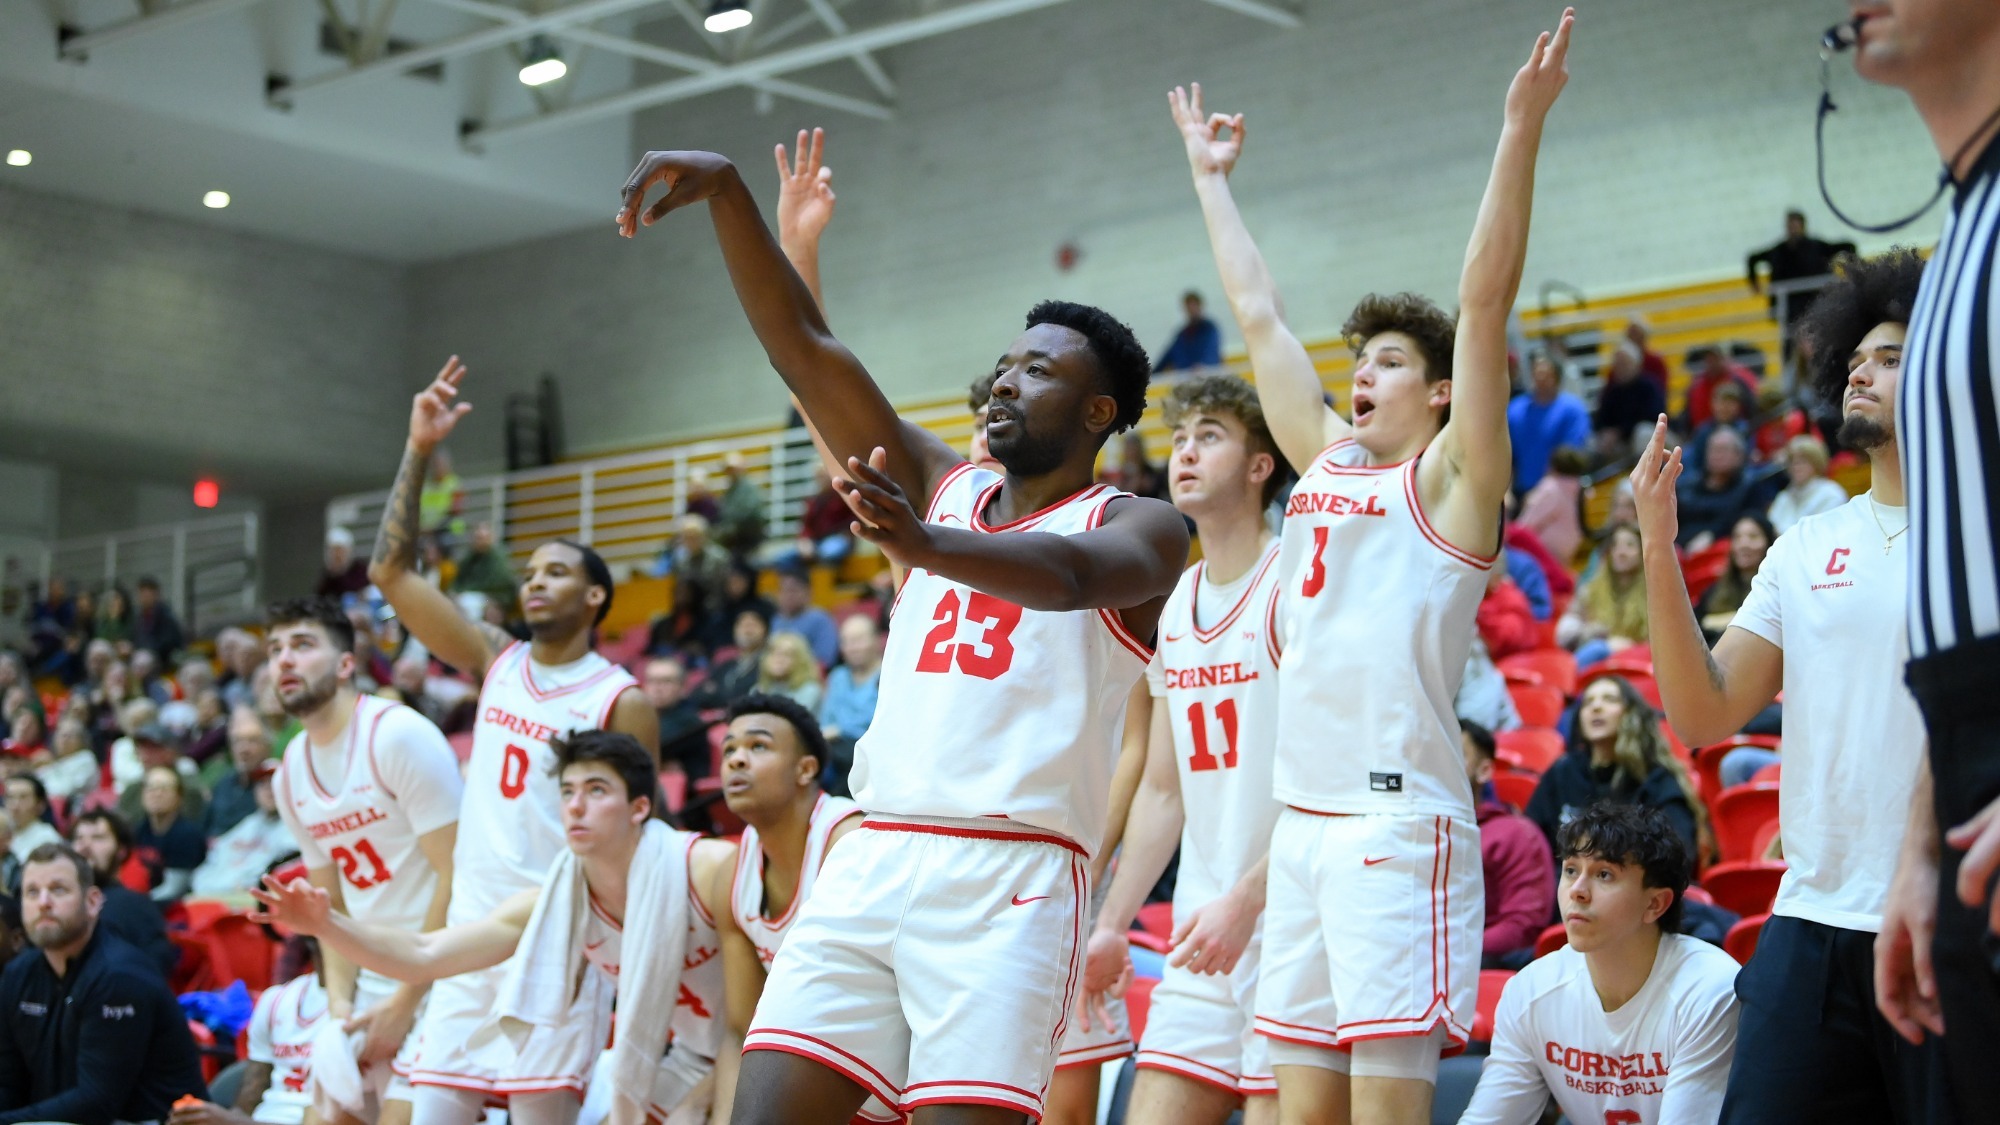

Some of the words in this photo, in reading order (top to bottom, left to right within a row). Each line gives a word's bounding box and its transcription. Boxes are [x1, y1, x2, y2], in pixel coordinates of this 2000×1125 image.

[1302, 526, 1329, 598] 3
[1826, 547, 1851, 576] C
[915, 588, 1024, 681] 23
[1187, 698, 1239, 772] 11
[500, 743, 530, 799] 0
[331, 837, 393, 890] 21
[1545, 1041, 1669, 1080] CORNELL
[1564, 1074, 1664, 1097] BASKETBALL
